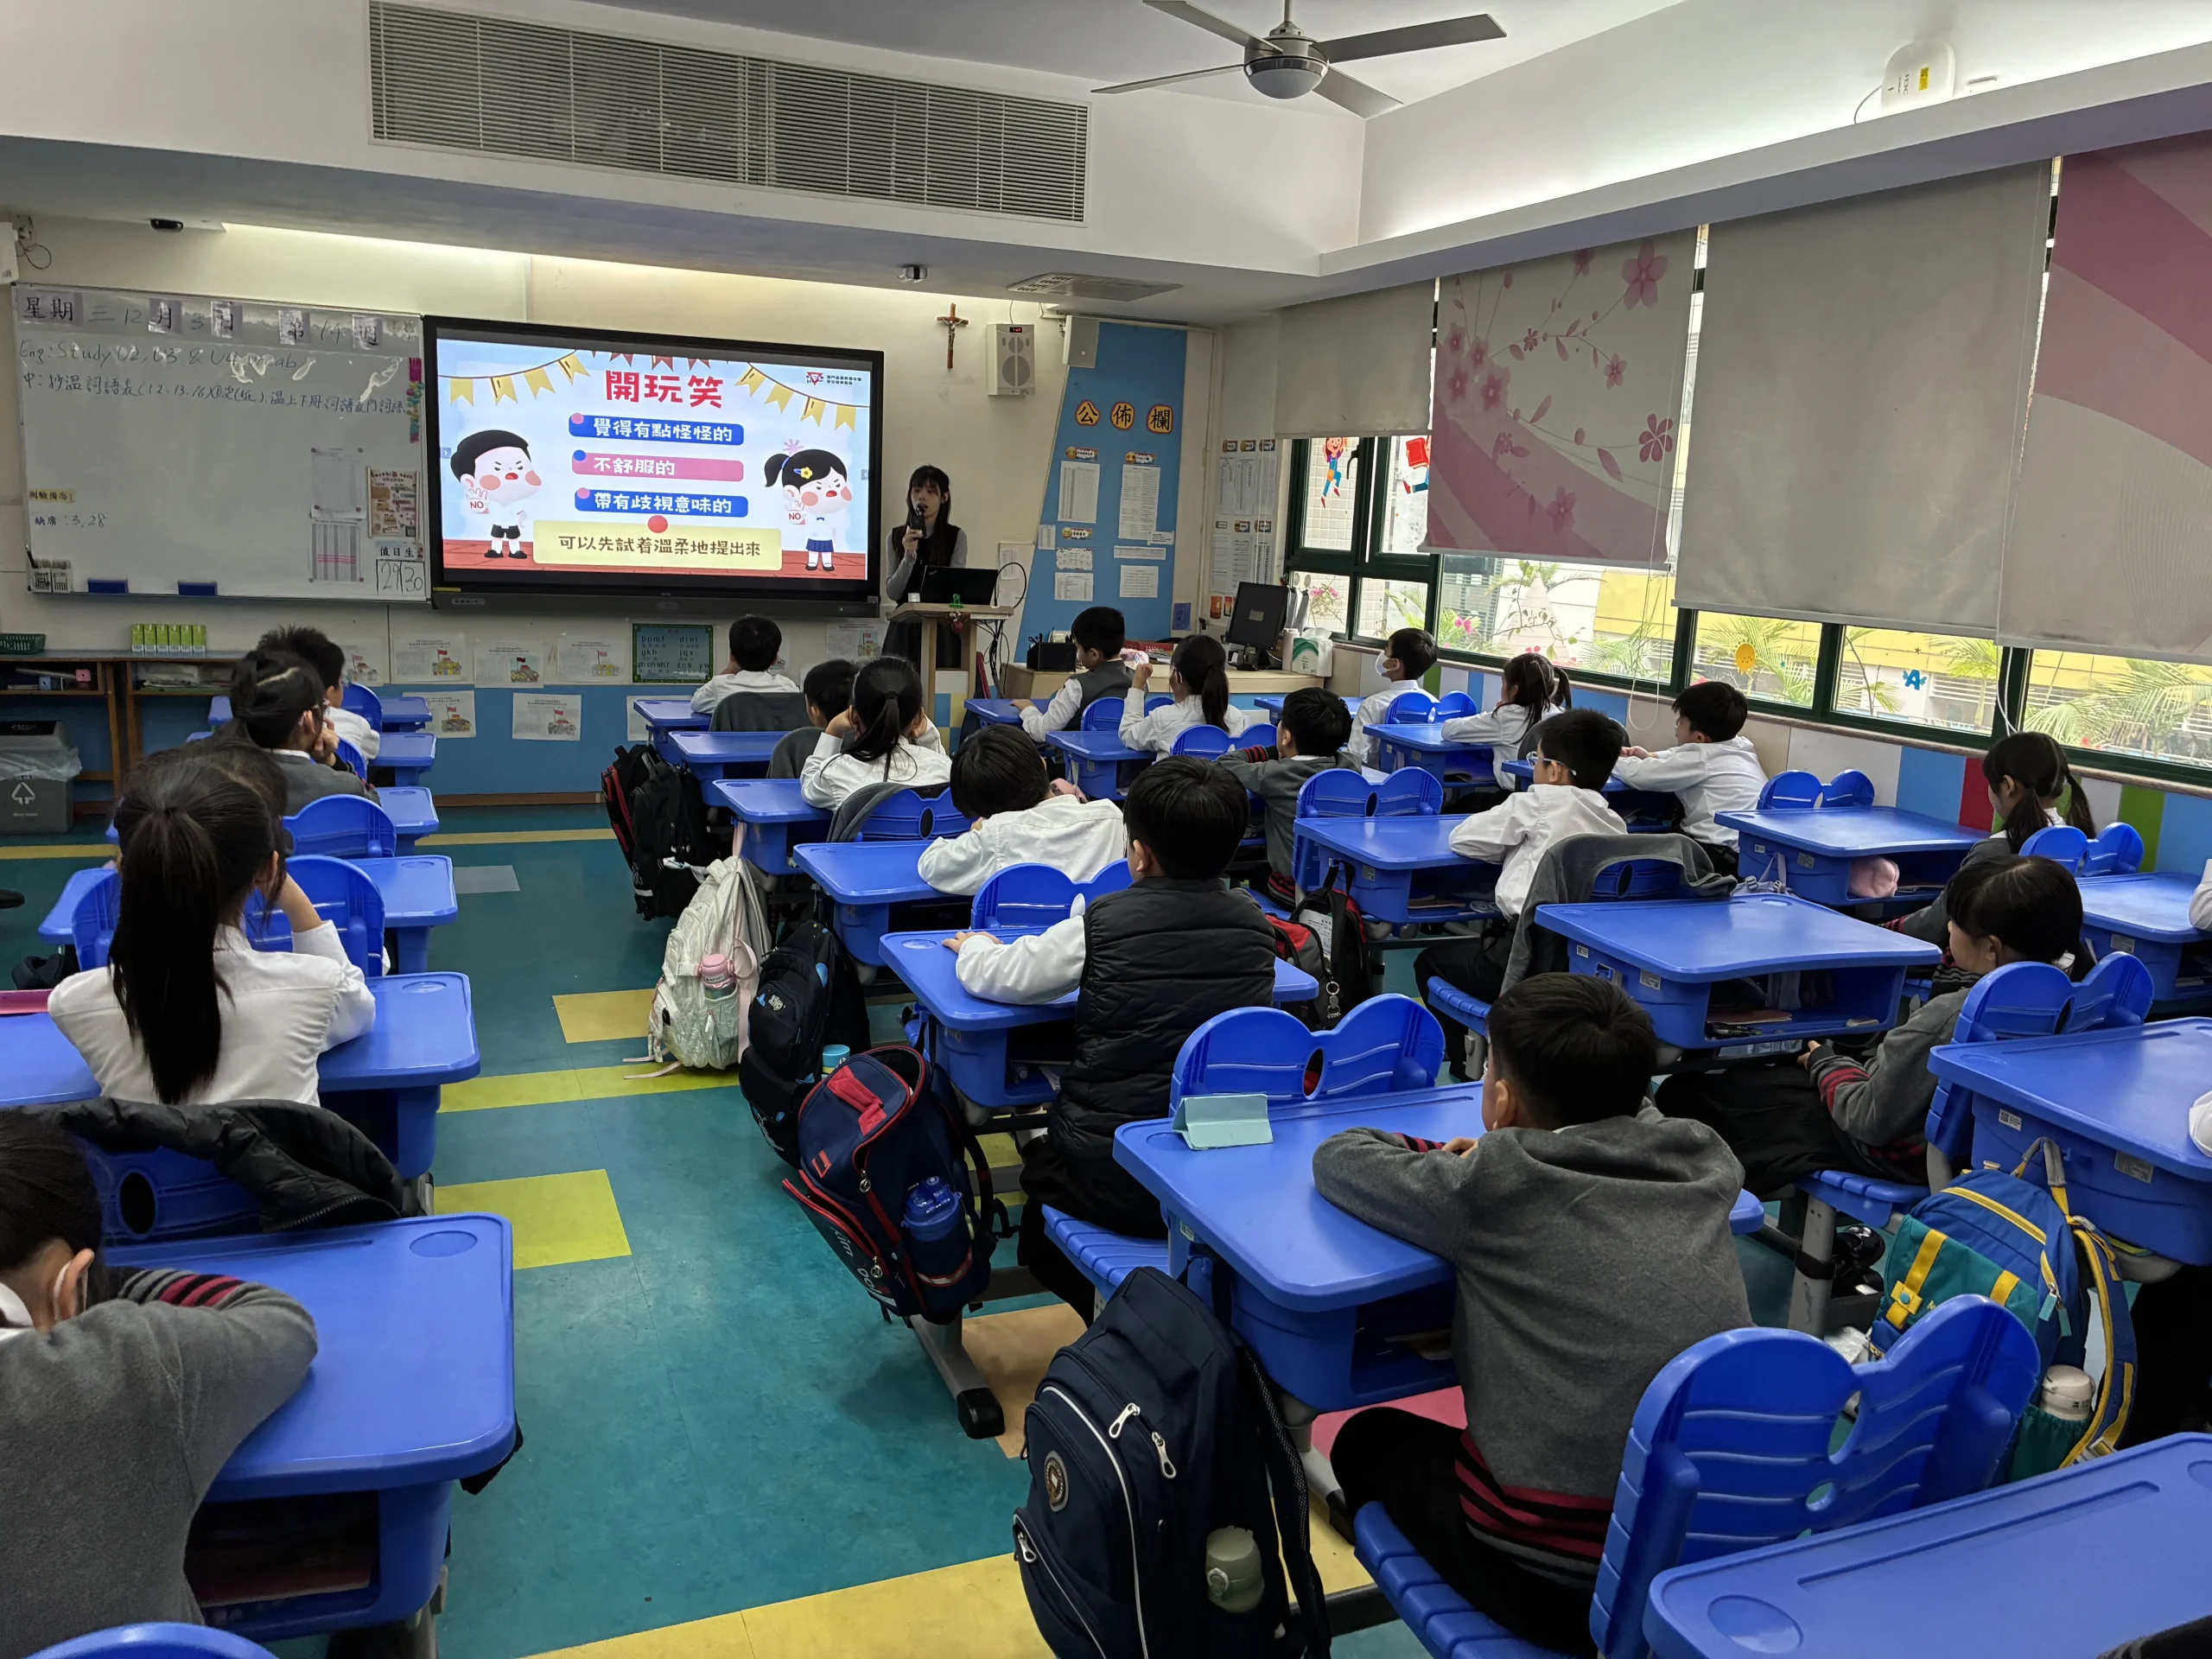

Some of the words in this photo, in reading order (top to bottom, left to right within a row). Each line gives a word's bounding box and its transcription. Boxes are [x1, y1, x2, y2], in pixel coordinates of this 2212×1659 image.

[22, 296, 73, 322] 星期
[88, 305, 115, 322] 三
[124, 308, 143, 326] 12
[58, 340, 111, 367] Study
[189, 347, 204, 365] &
[605, 370, 724, 409] 開玩笑
[1077, 402, 1171, 431] 公佈欄
[594, 417, 733, 442] 覺得有點怪怪的
[594, 457, 676, 476] 不舒服的
[594, 492, 732, 514] 帶有歧視意味的
[88, 512, 107, 529] 28
[380, 546, 415, 559] 值日生
[404, 566, 423, 593] 30
[1904, 670, 1920, 690] A
